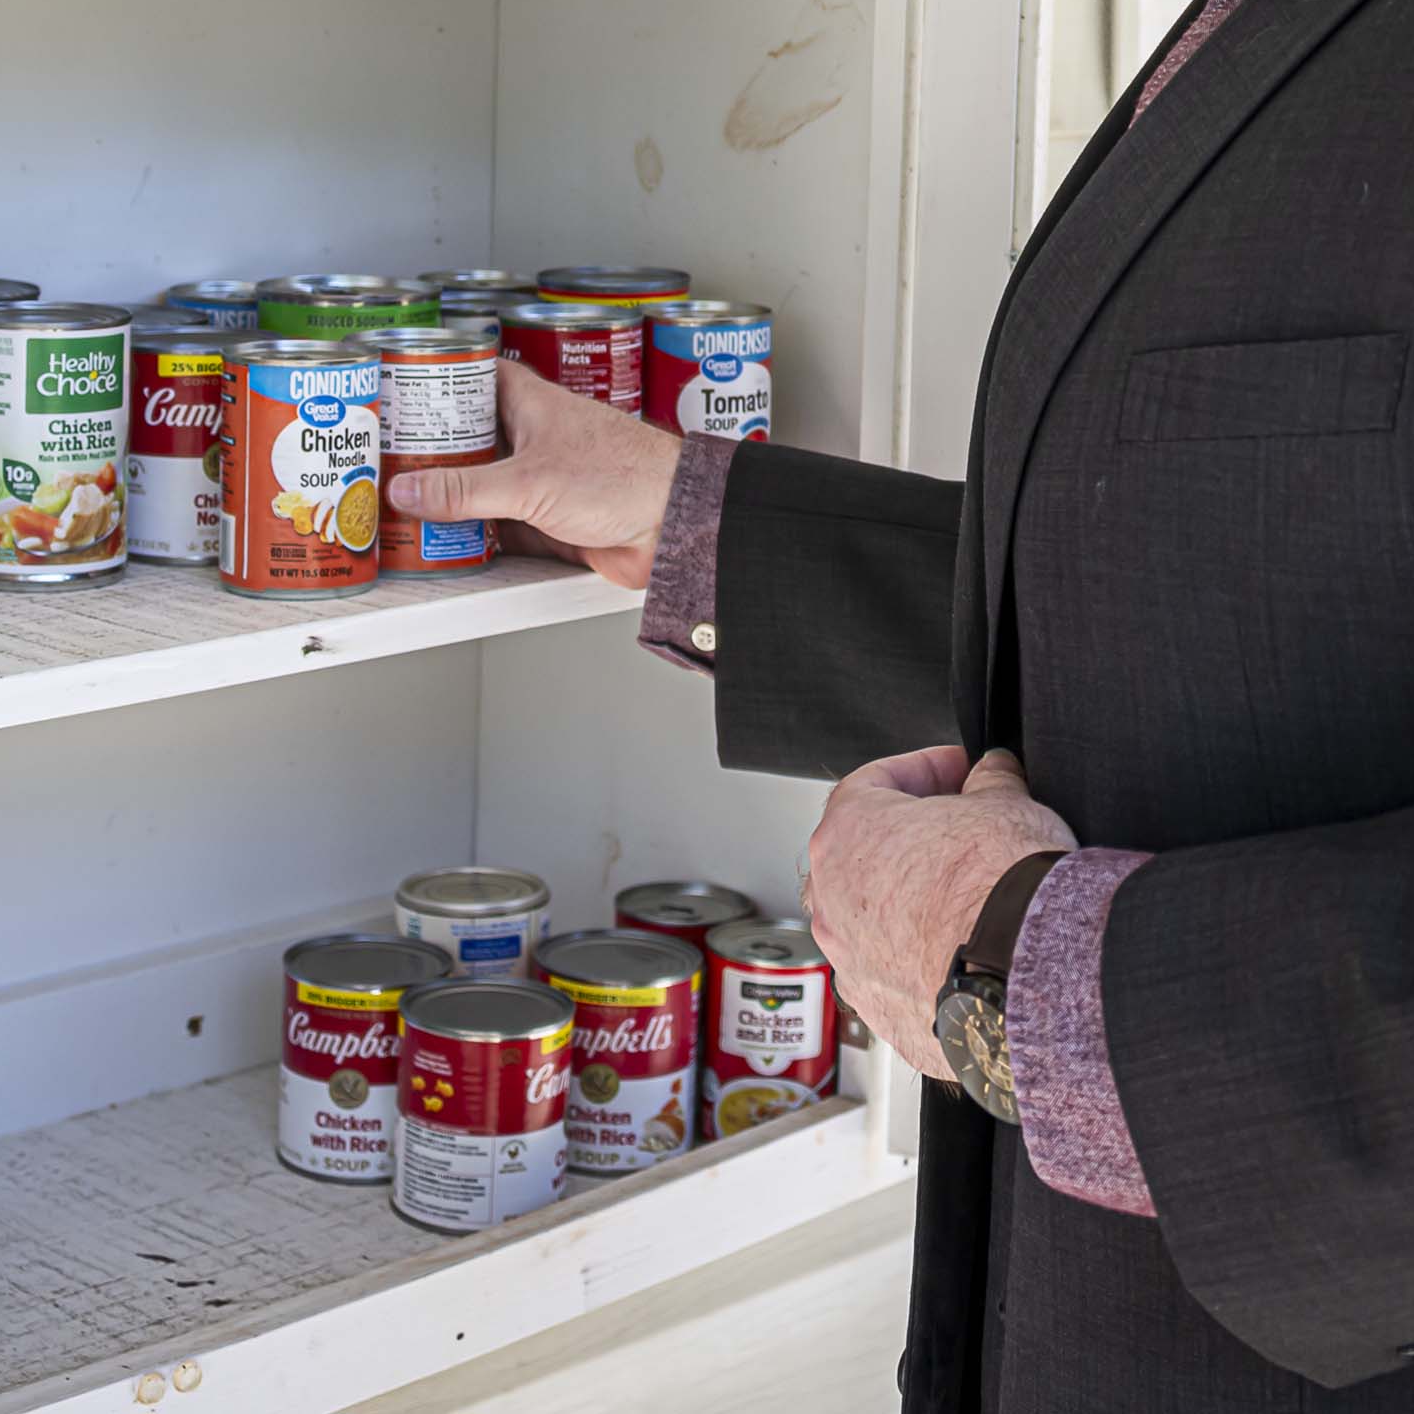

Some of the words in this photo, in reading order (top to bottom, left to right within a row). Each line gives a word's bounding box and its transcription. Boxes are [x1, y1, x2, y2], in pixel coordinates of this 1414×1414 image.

[307, 314, 354, 328] REDUCED
[356, 314, 395, 328] SODIUM
[562, 342, 608, 353] Nutrition
[49, 352, 116, 374] Healthy
[171, 362, 194, 373] 25%
[562, 355, 591, 365] Facts
[706, 359, 737, 371] Great
[714, 369, 737, 378] Value
[36, 370, 117, 397] Choice
[304, 402, 340, 415] Great
[701, 388, 769, 415] Tomato
[313, 414, 339, 422] Value
[704, 418, 738, 431] SOUP
[48, 419, 112, 435] Chicken
[41, 436, 83, 452] with
[87, 435, 116, 450] Rice
[301, 428, 371, 453] Chicken
[328, 452, 367, 469] Noodle
[5, 466, 33, 483] 10g
[300, 472, 339, 488] SOUP
[270, 568, 285, 577] NET
[286, 569, 299, 577] WT
[301, 568, 319, 578] 10.5
[319, 567, 331, 578] OZ
[738, 1010, 804, 1028] Chicken
[737, 1029, 766, 1043] and
[772, 1030, 805, 1044] Rice
[315, 1112, 382, 1132] Chicken
[568, 1106, 632, 1126] Chicken
[310, 1133, 347, 1152] with
[349, 1135, 388, 1153] Rice
[599, 1130, 636, 1147] Rice
[324, 1157, 370, 1172] SOUP
[574, 1150, 621, 1164] SOUP
